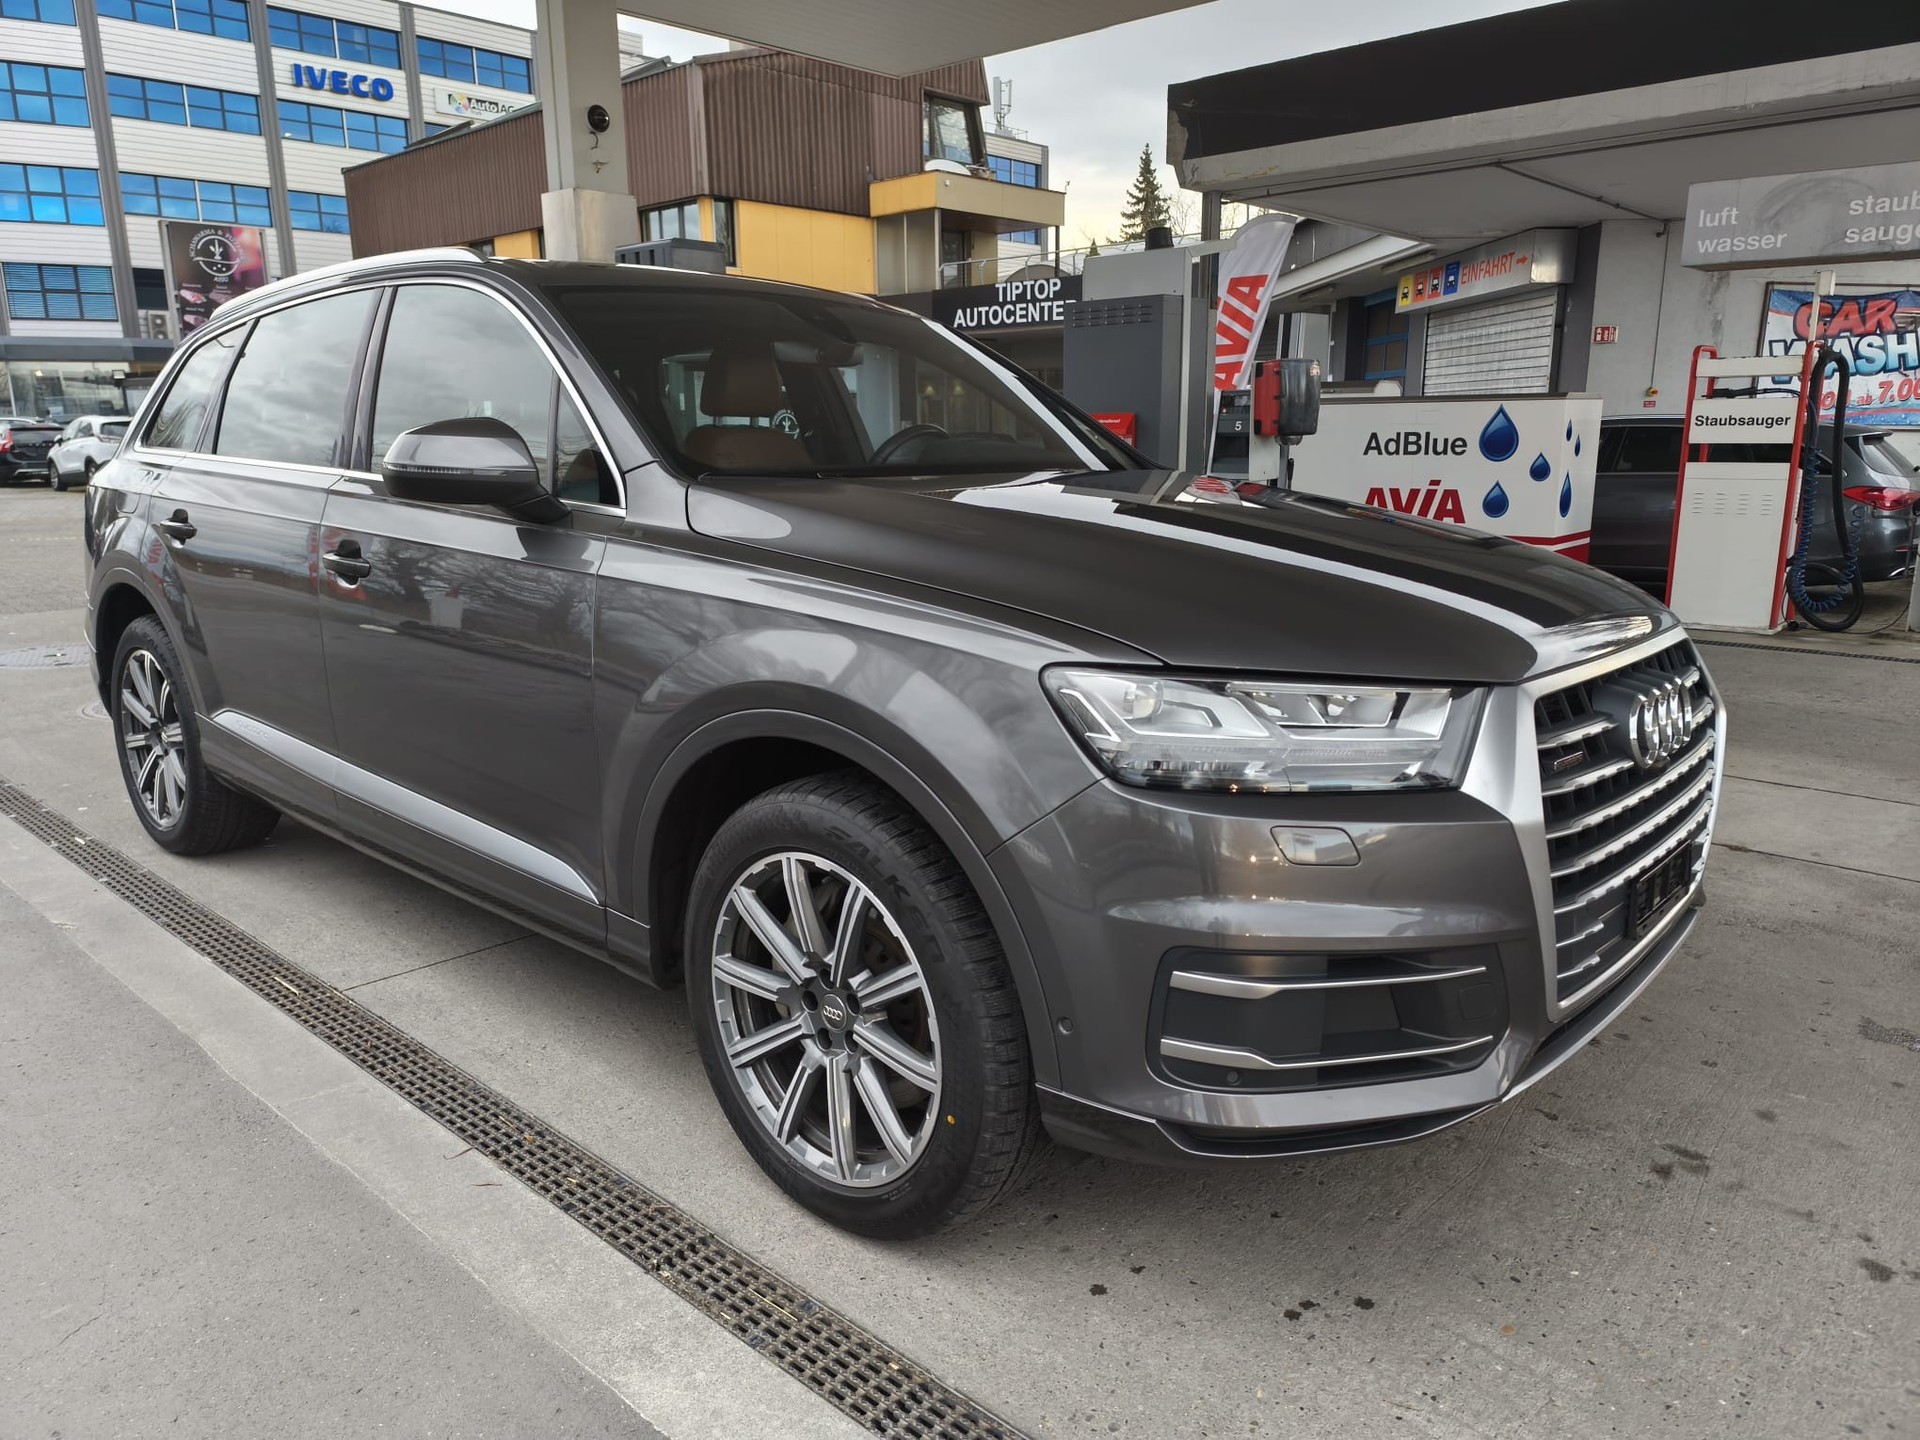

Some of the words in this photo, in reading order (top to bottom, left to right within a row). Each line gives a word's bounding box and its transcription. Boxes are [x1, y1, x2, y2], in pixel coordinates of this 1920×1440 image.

[292, 63, 394, 102] IVECO
[470, 98, 498, 113] Auto
[1698, 207, 1739, 227] luft
[1697, 232, 1788, 253] wasser
[1460, 251, 1516, 285] EINFAHRT
[995, 278, 1062, 302] TIPTOP
[953, 300, 1077, 328] AUTOCENTE
[1793, 298, 1898, 338] CAR
[1234, 421, 1242, 431] 5
[1695, 414, 1791, 429] Staubsauger
[1363, 431, 1468, 456] AdBlue
[824, 826, 946, 963] FALKEN
